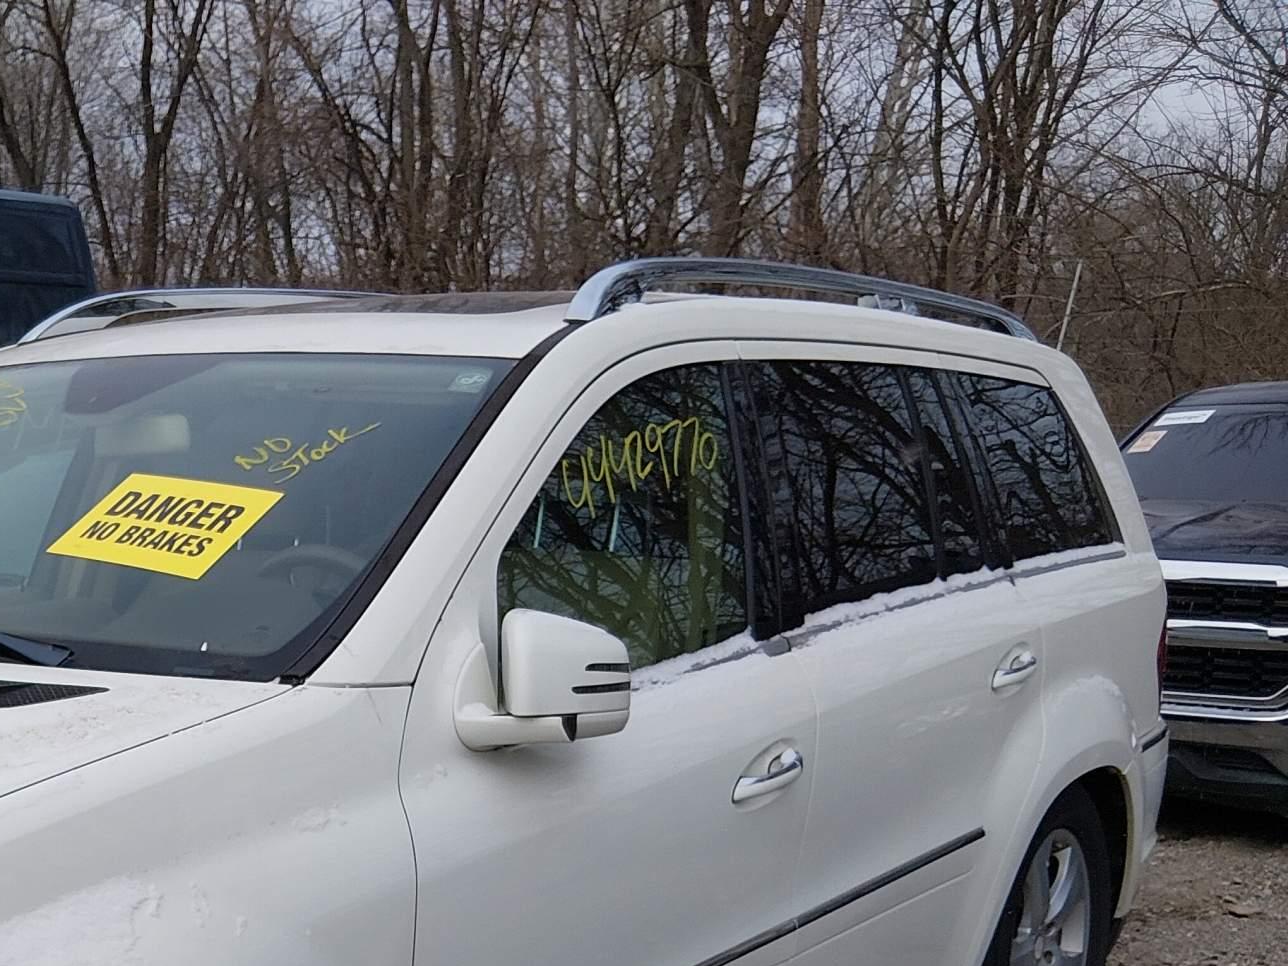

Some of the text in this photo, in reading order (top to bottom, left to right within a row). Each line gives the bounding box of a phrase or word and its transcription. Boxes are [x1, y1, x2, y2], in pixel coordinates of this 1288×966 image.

[234, 437, 292, 471] NO
[562, 416, 718, 519] 44429770
[104, 490, 245, 534] DANGER
[80, 520, 213, 557] NO BRAKES
